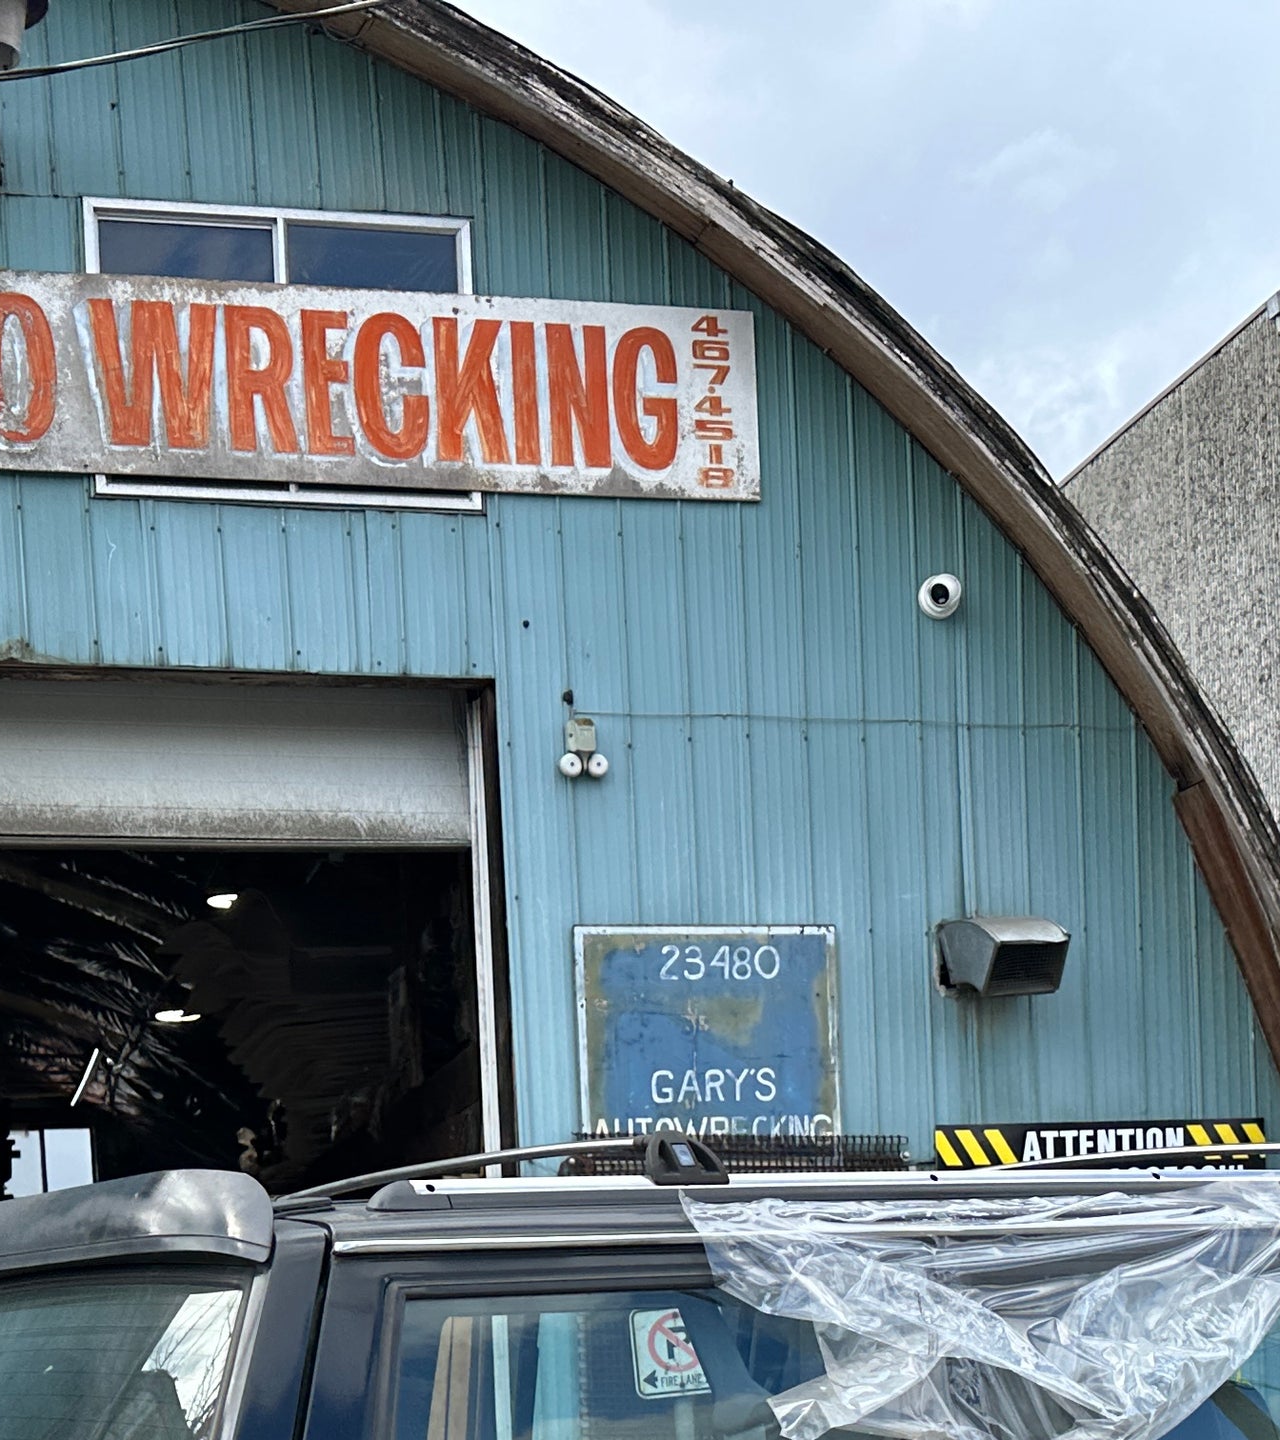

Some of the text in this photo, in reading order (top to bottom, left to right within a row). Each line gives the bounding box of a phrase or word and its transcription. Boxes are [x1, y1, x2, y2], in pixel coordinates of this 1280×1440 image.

[86, 297, 680, 472] WRECKING
[659, 944, 781, 980] 23480
[651, 1066, 777, 1105] GARY'S
[1022, 1126, 1184, 1162] ATTENTION
[660, 1375, 678, 1388] FIRE
